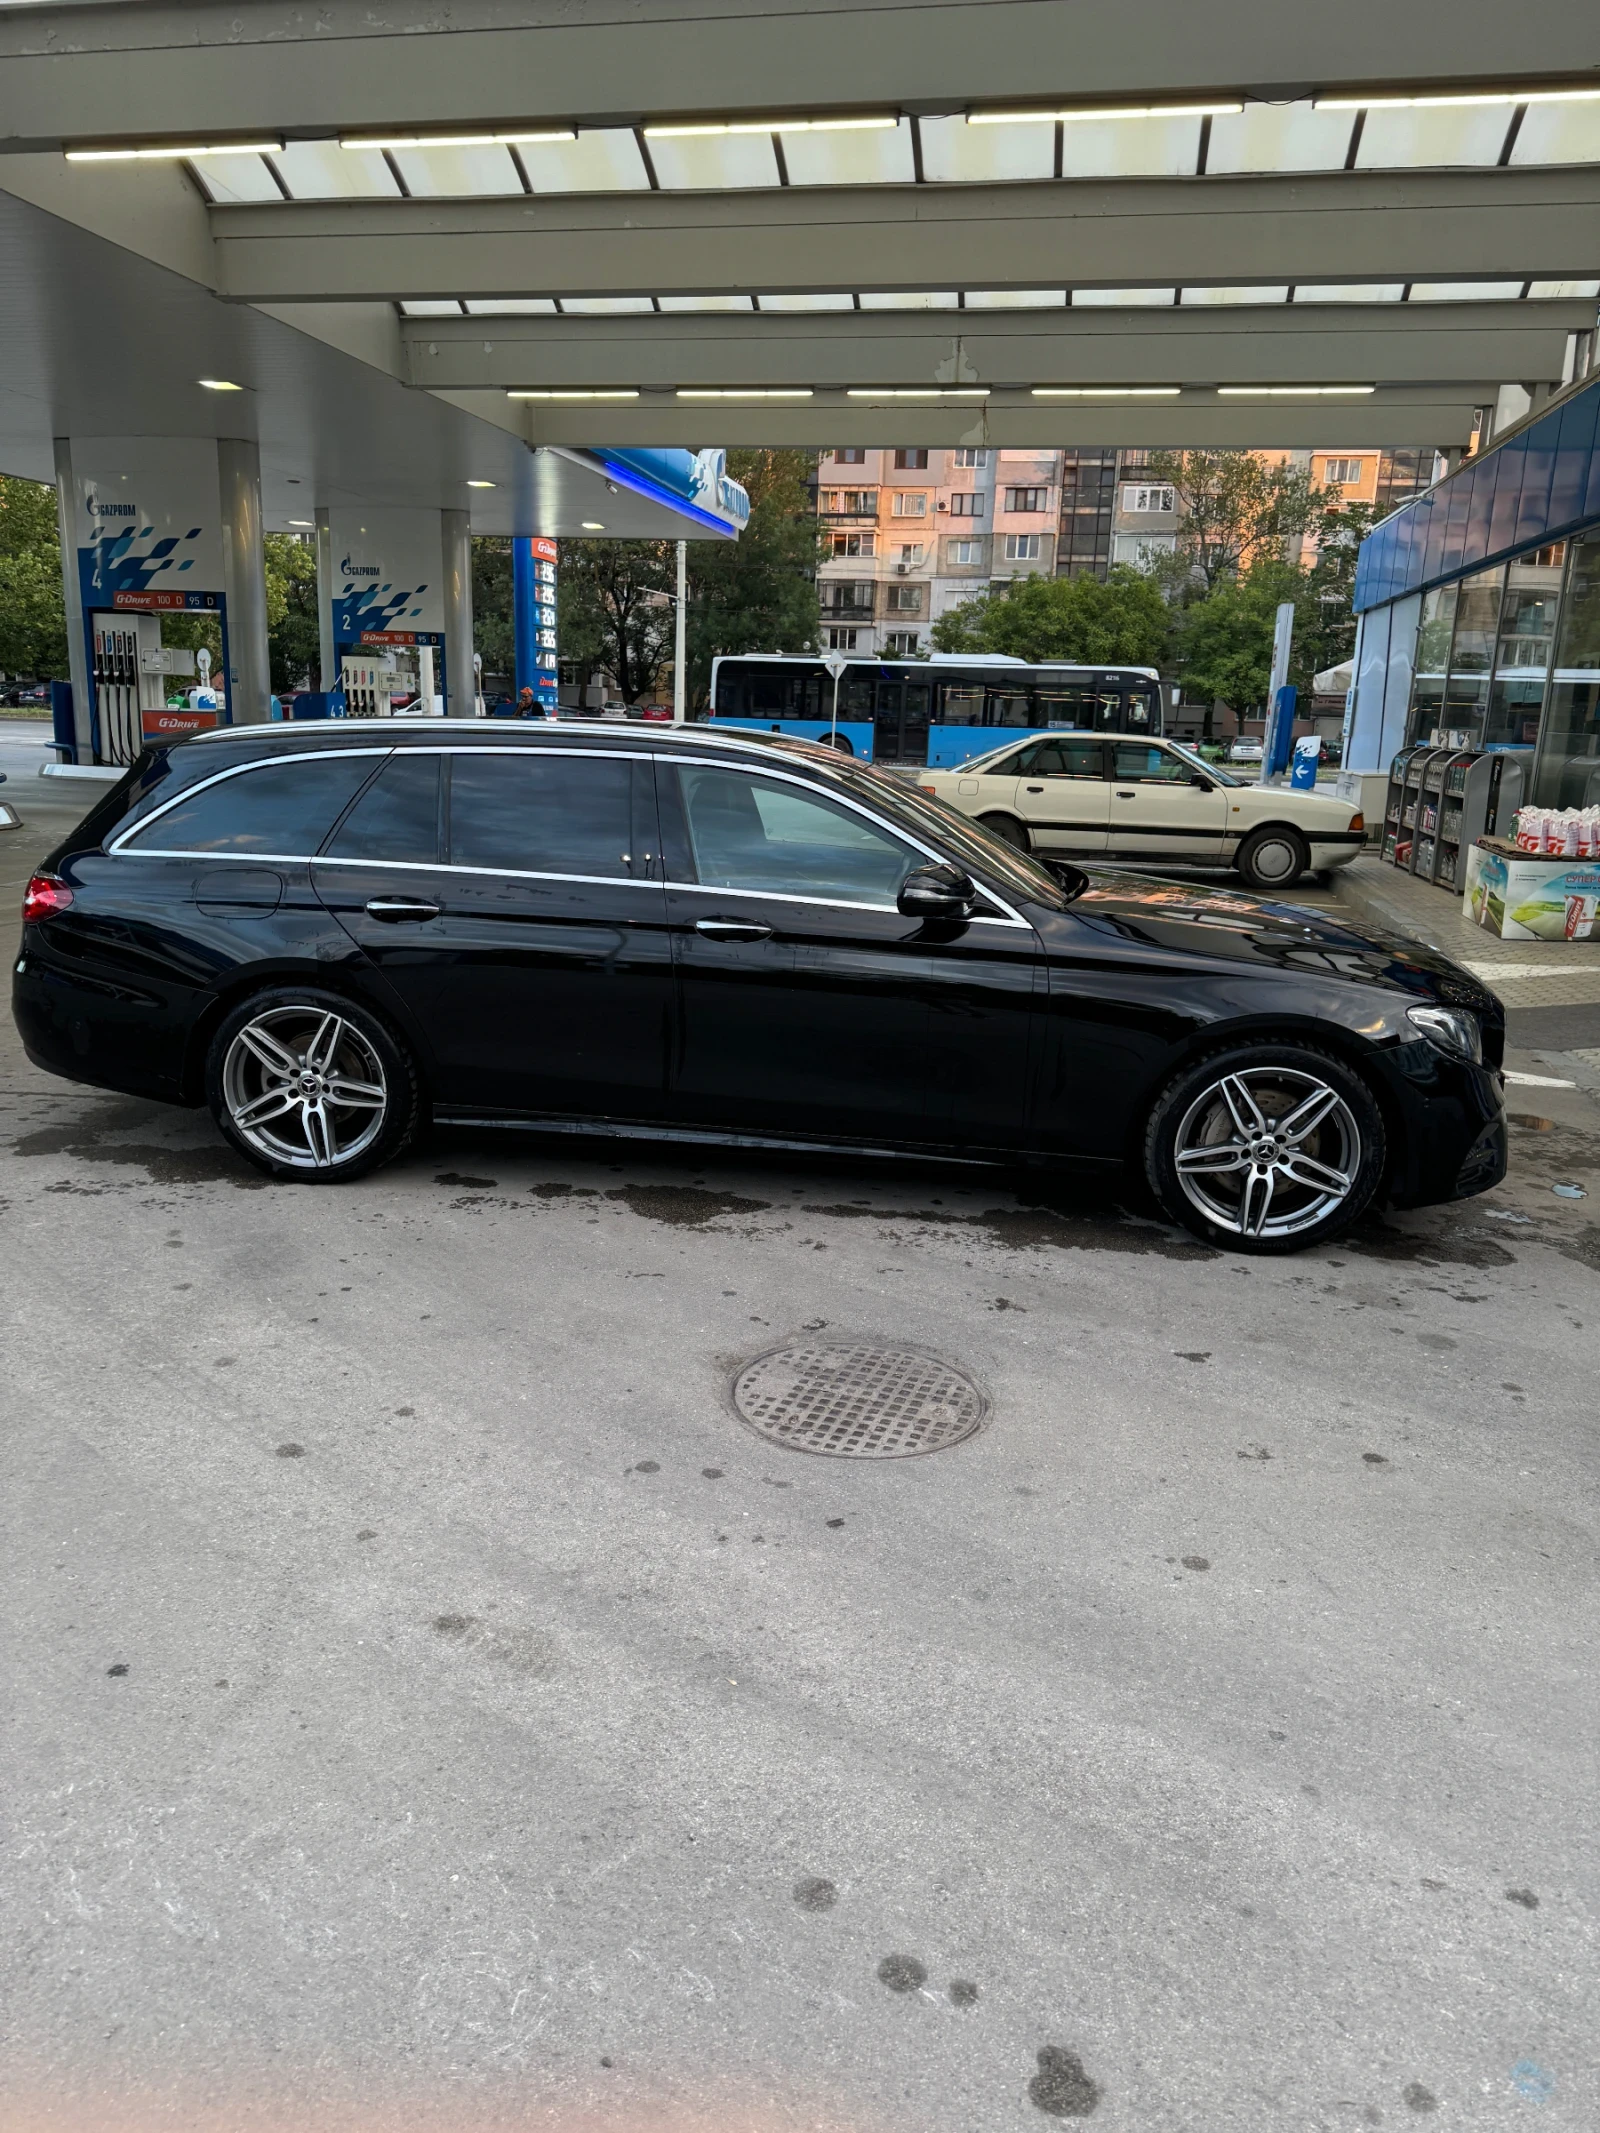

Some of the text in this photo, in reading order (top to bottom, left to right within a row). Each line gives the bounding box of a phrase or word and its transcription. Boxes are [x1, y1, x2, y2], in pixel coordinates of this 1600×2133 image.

[100, 504, 136, 516] GAZPROM
[351, 566, 380, 576] GAZPROM
[92, 569, 102, 589] 4
[157, 595, 170, 605] 100
[176, 596, 183, 605] D
[189, 596, 200, 606] 95
[207, 597, 214, 606] D
[342, 614, 351, 630] 2
[394, 634, 404, 642] 100
[408, 635, 414, 643] D
[418, 635, 427, 643] 95
[330, 705, 344, 718] 4 3
